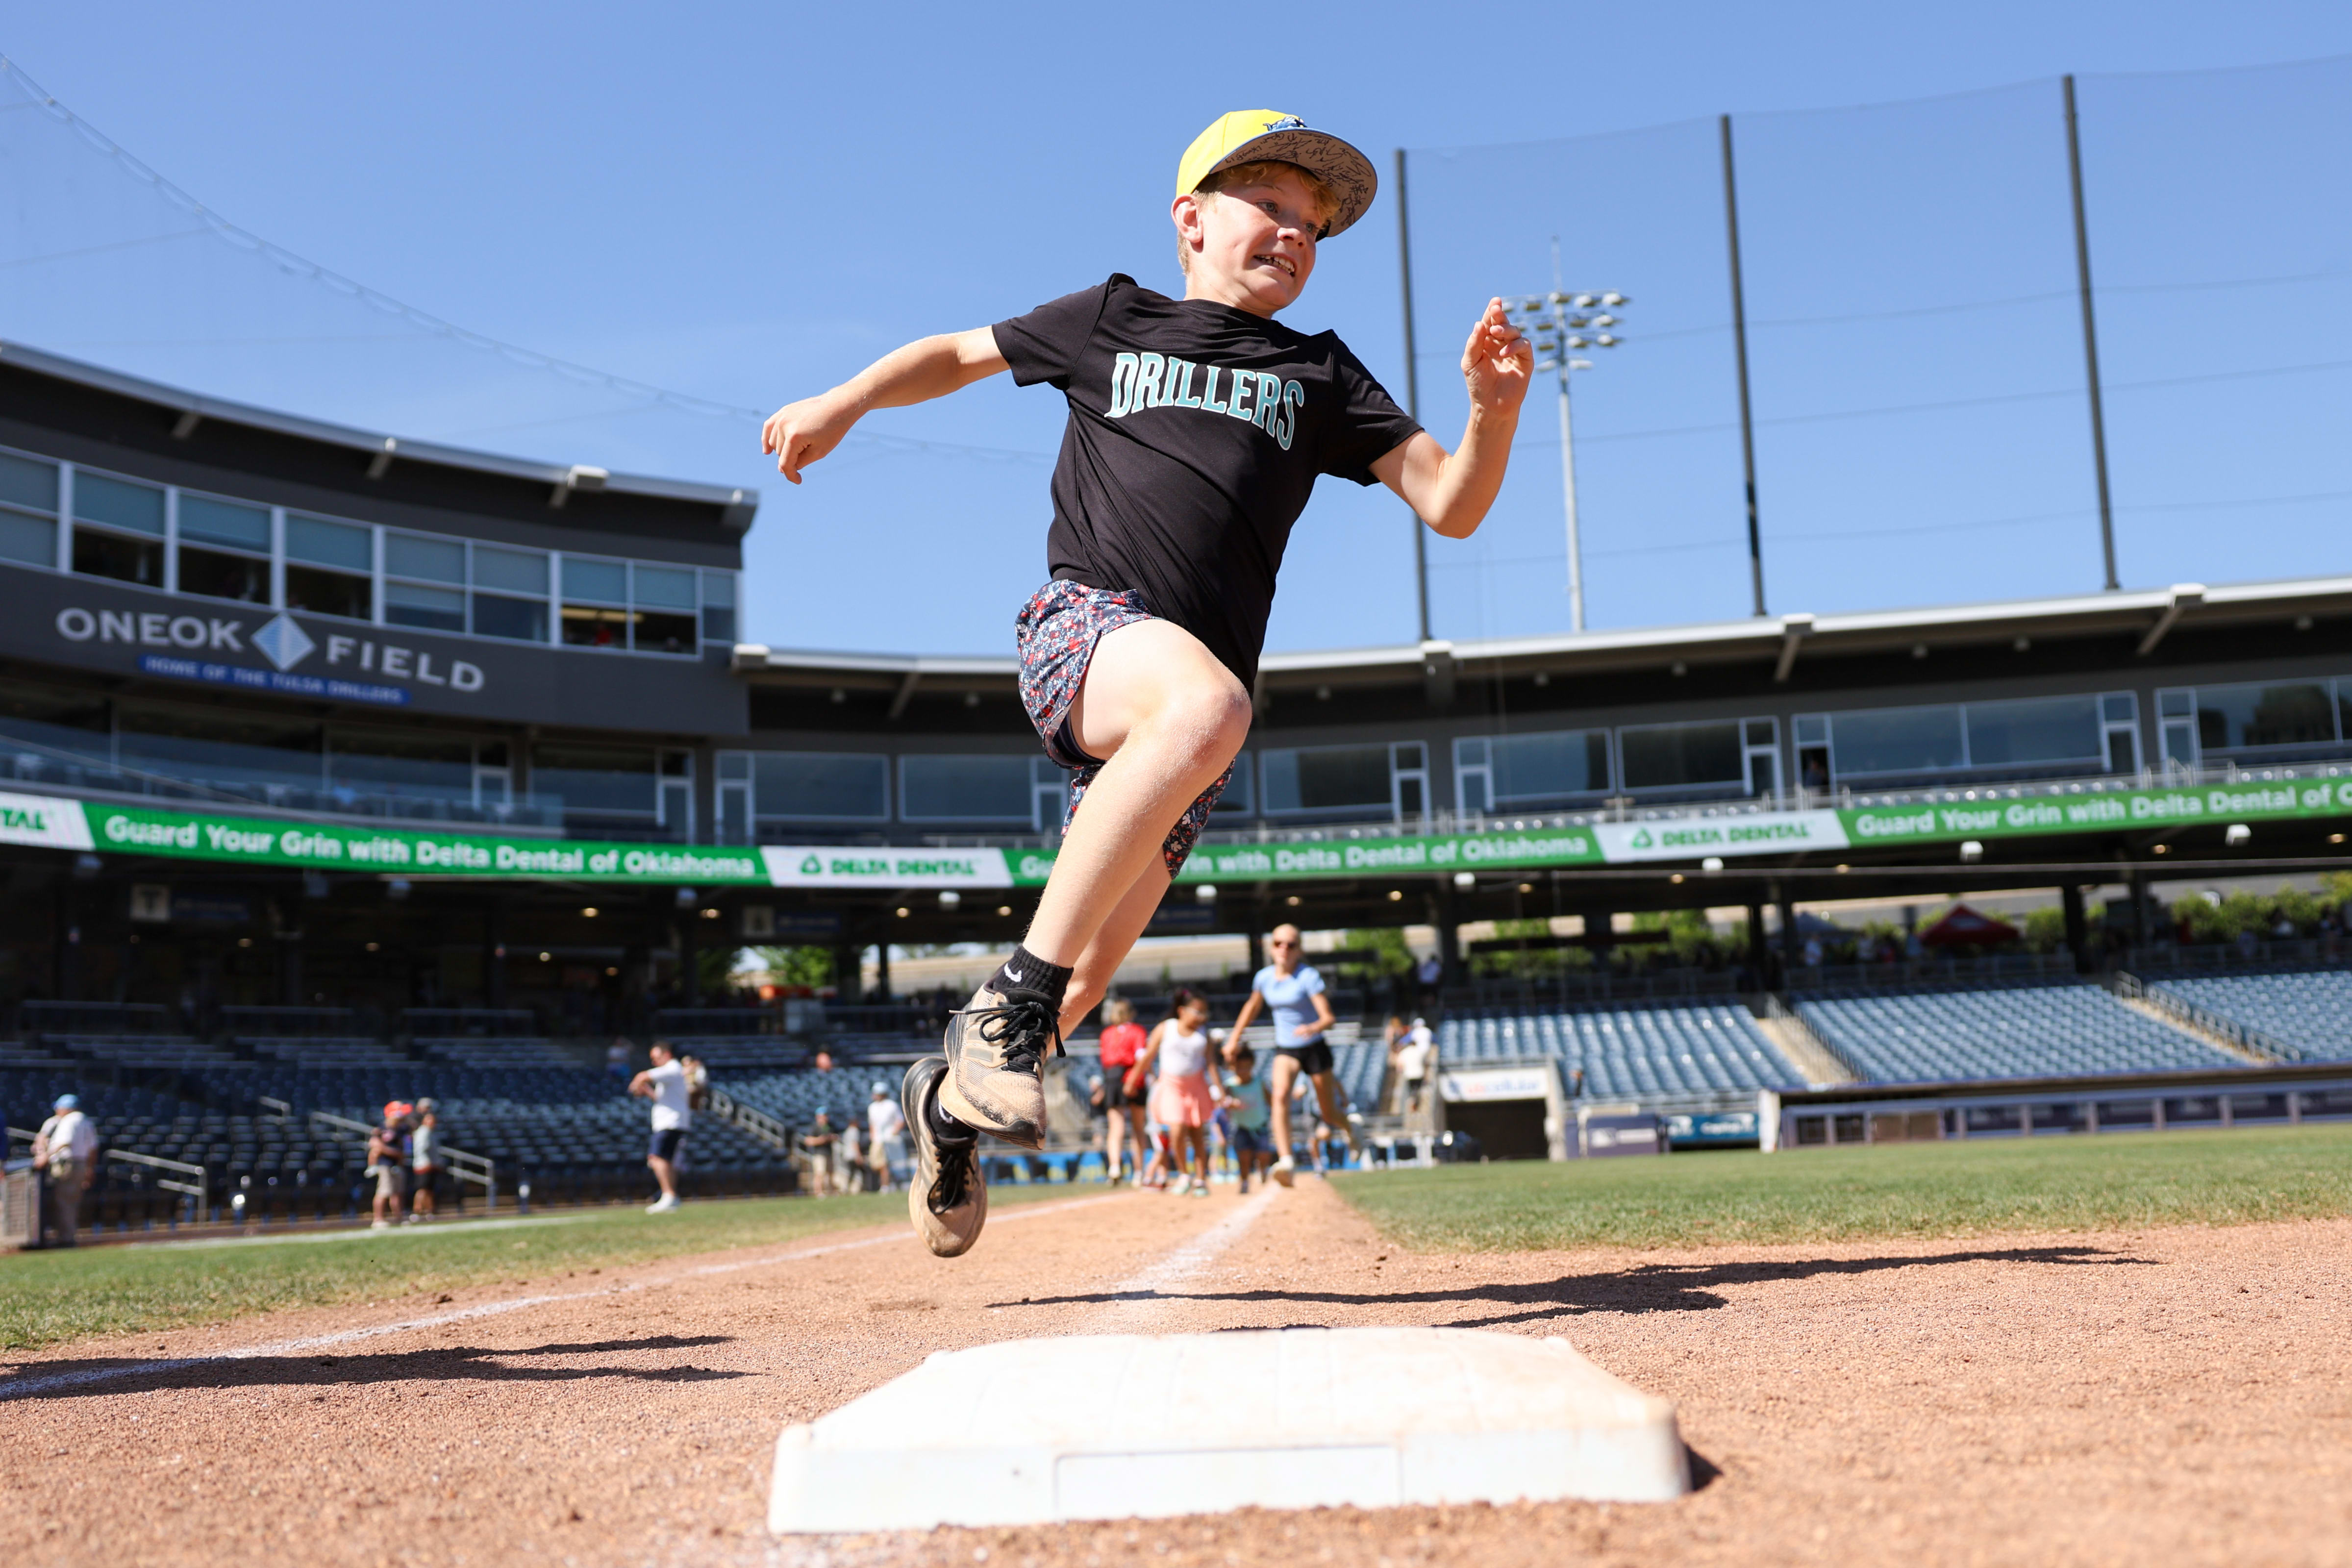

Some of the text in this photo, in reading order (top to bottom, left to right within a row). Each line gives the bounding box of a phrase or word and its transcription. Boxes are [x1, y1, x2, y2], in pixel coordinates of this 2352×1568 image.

[1104, 352, 1304, 450] DRILLERS
[56, 607, 484, 692] ONEOK FIELD
[146, 656, 402, 701] HOME OF THE TULSA DRILLERS
[1663, 822, 1809, 847] DELTA DENTAL
[1856, 810, 1935, 837] Guard
[1941, 809, 2001, 830] Your
[2006, 803, 2062, 827] Grin
[2067, 797, 2126, 822] with
[2131, 793, 2203, 819] Delta
[2208, 786, 2297, 814] Dental
[2302, 784, 2332, 809] of
[104, 815, 755, 876] Guard Your Grin with Delta Dental of Oklahoma
[832, 859, 975, 875] DELTA DENTAL
[1218, 850, 1272, 872] with
[1276, 848, 1342, 871] Delta
[1346, 842, 1426, 867] Dental
[1430, 840, 1458, 864] of
[1462, 836, 1589, 863] Oklahoma
